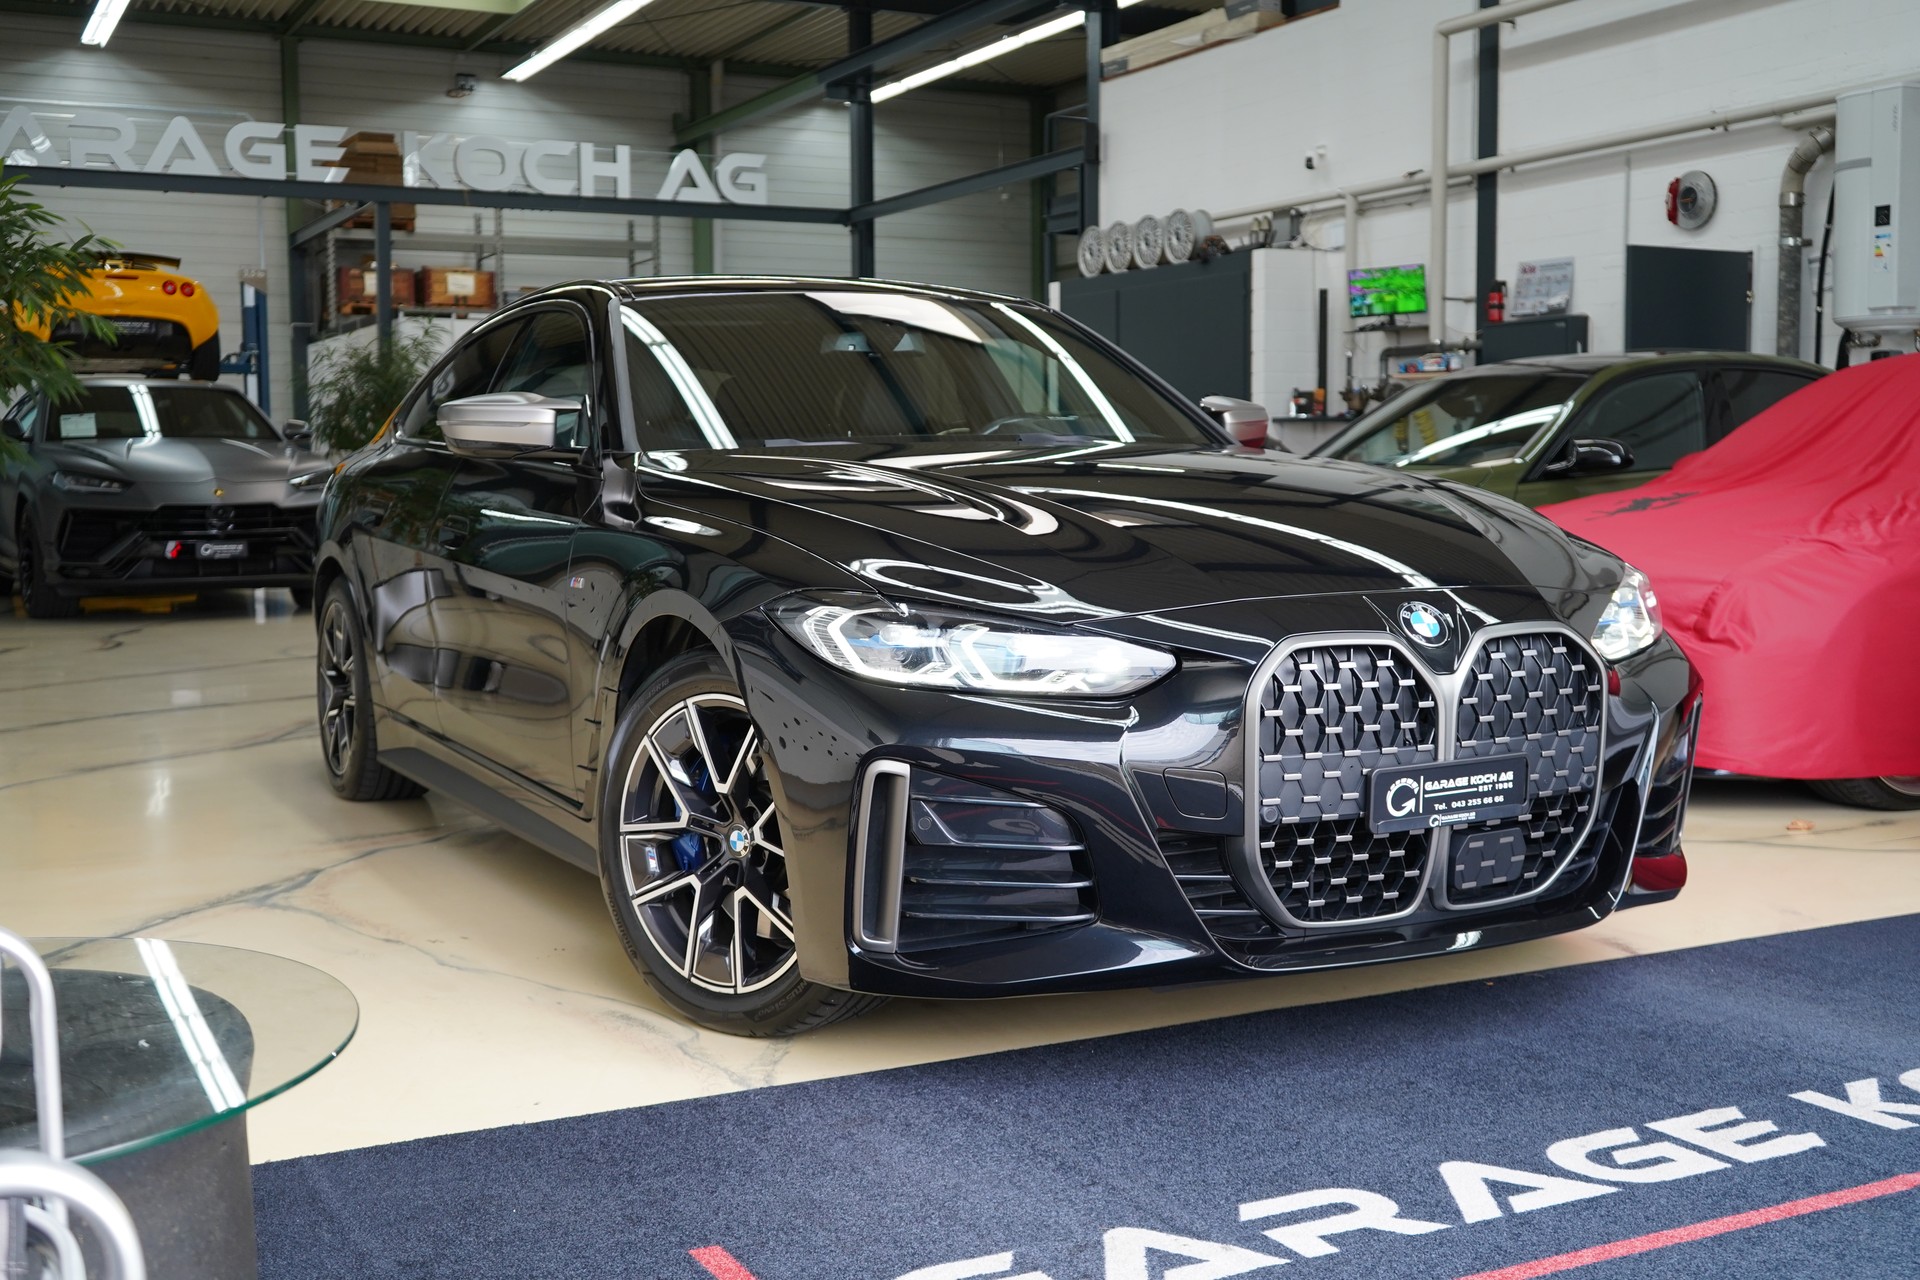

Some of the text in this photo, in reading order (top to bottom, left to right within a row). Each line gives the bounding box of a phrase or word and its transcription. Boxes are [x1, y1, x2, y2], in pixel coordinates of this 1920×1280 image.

[403, 130, 631, 198] KOCH
[656, 148, 768, 205] AG
[1424, 771, 1514, 791] GARAGE KOCH AG
[1479, 782, 1514, 792] EST 1986
[1434, 802, 1448, 811] Tel.
[1451, 800, 1466, 808] 043
[1467, 797, 1482, 806] 255
[1494, 795, 1504, 803] 66
[1789, 1069, 1920, 1131] K
